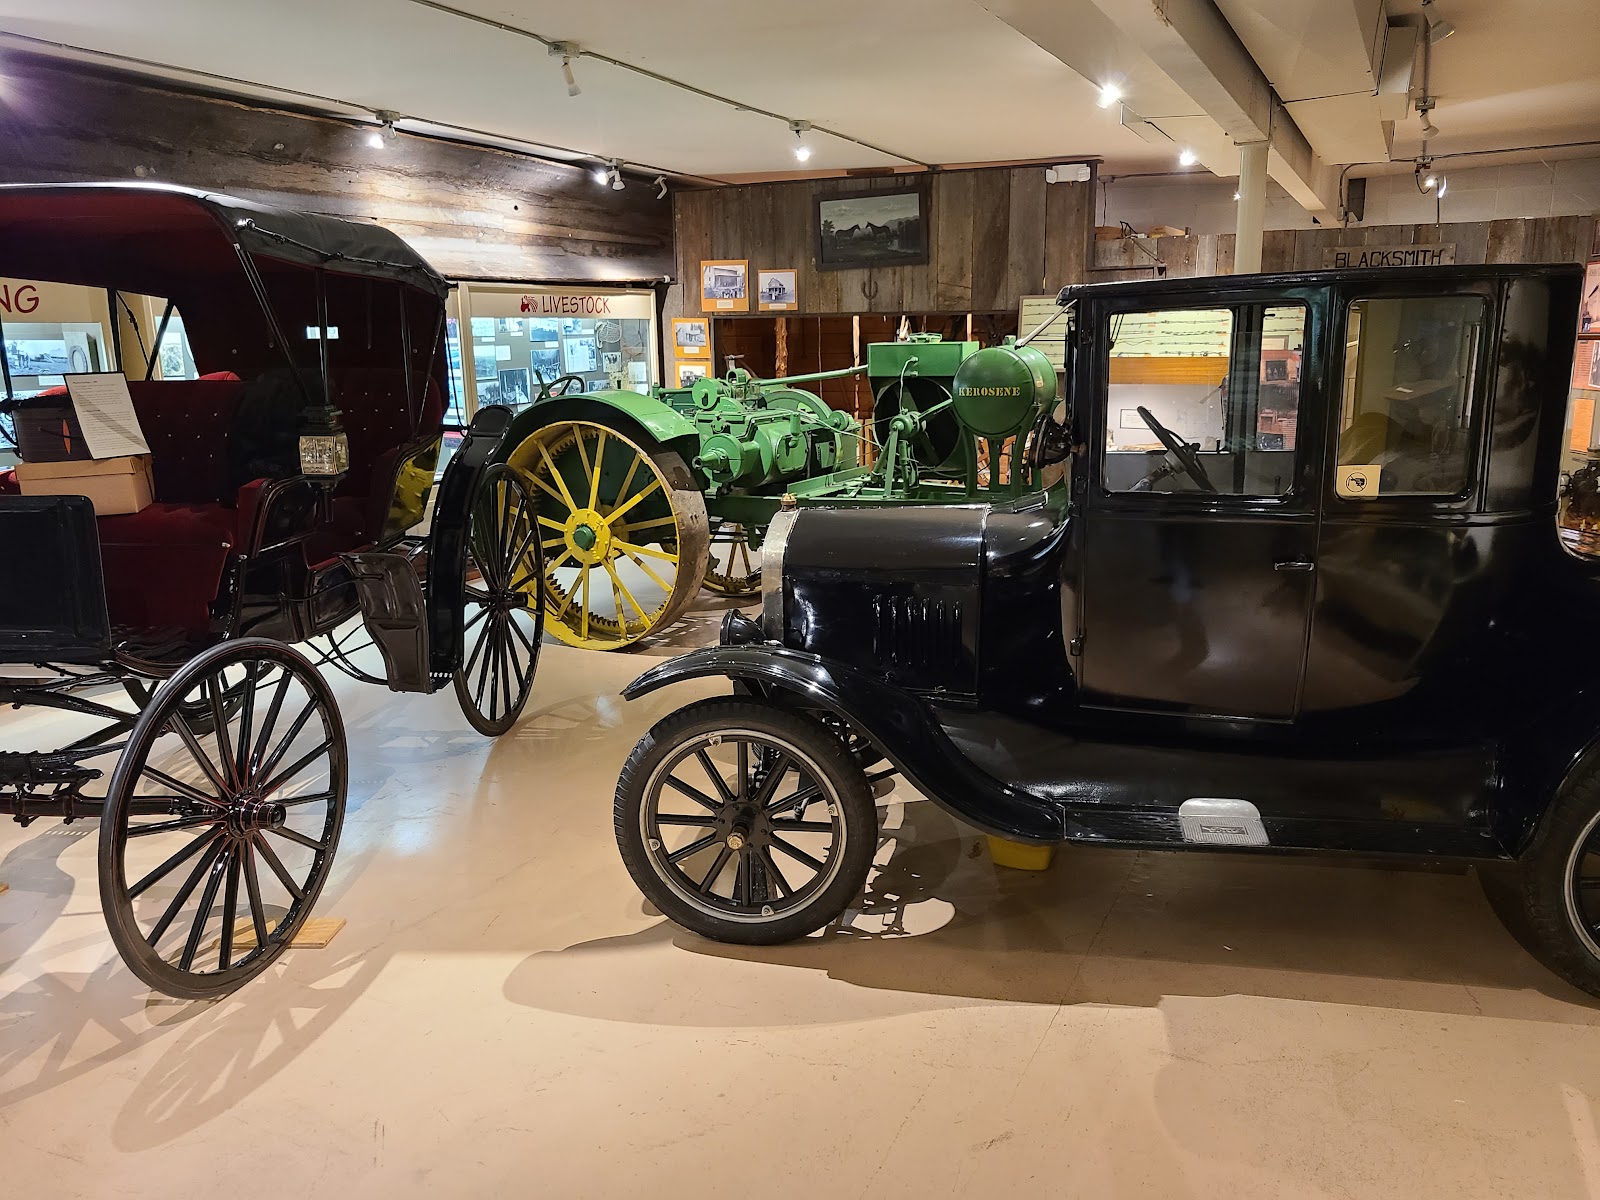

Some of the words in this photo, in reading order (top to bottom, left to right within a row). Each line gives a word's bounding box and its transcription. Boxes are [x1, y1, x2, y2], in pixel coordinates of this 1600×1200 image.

[1335, 249, 1443, 268] BLACKSMITH
[541, 295, 611, 314] LIVESTOCK
[958, 386, 1021, 397] KEROSENE
